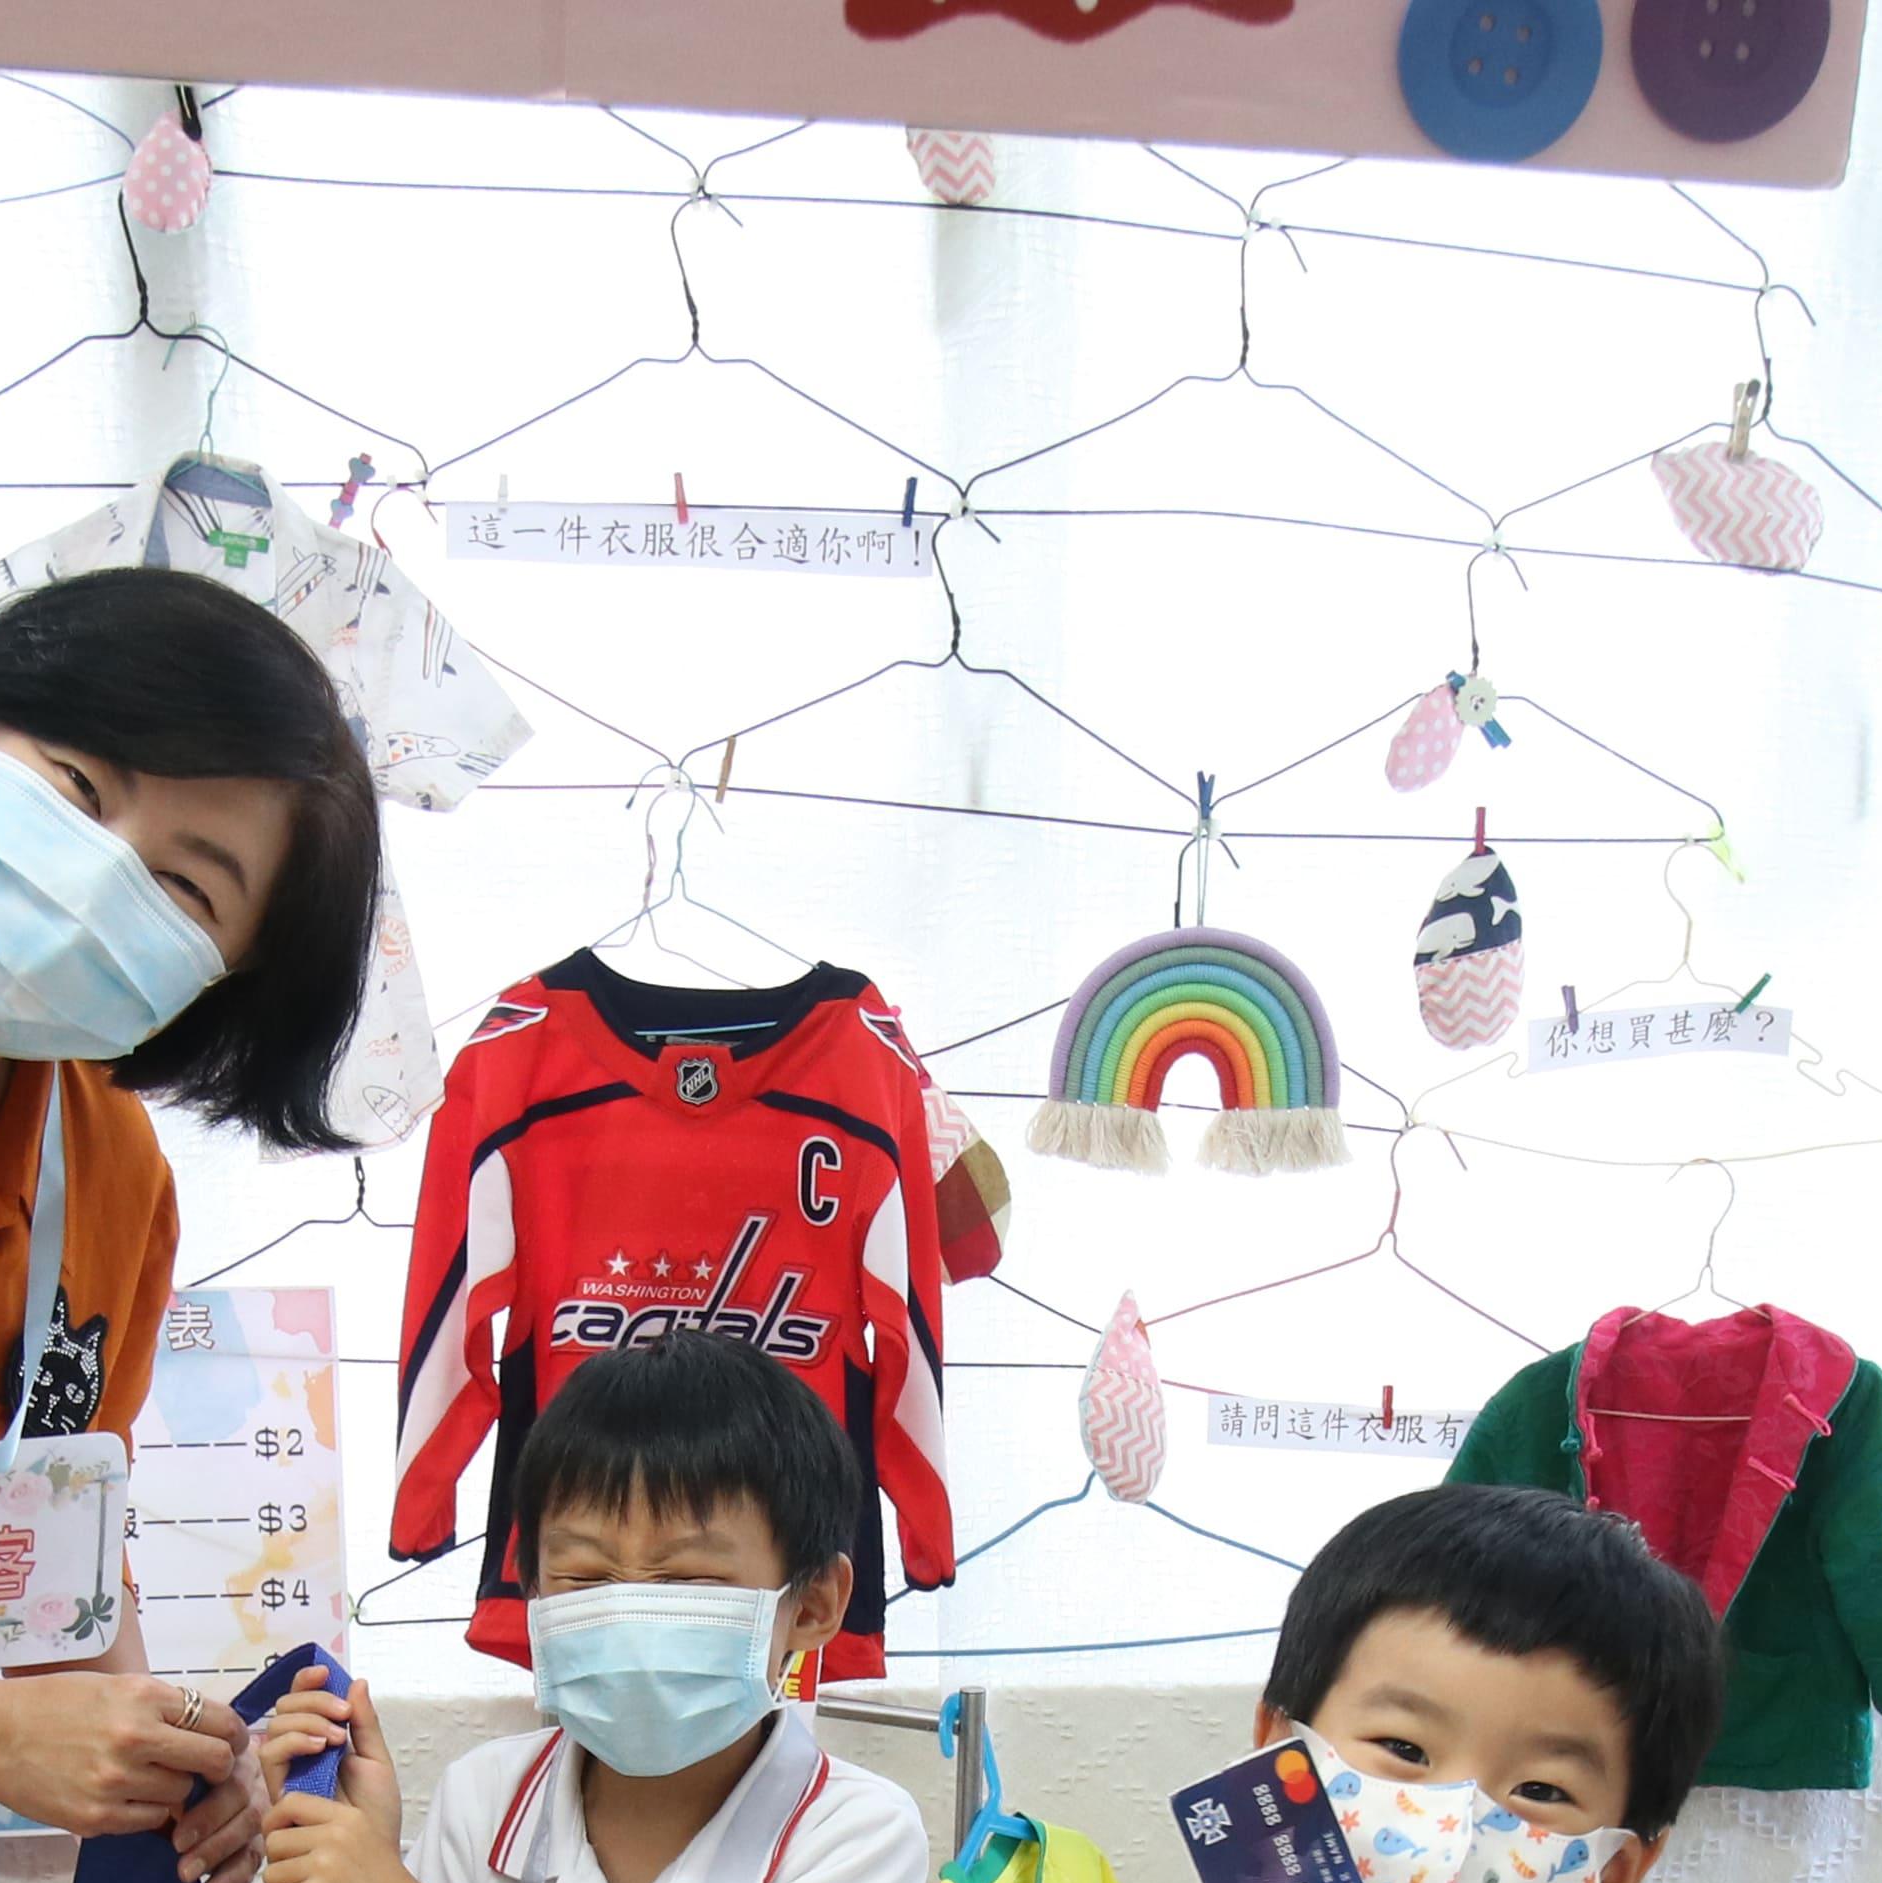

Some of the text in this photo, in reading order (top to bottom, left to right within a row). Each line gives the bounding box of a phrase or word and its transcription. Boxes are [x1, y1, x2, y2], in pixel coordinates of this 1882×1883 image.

[685, 1064, 711, 1095] NHL
[797, 1136, 842, 1227] C
[581, 1281, 707, 1301] WASHINGTON
